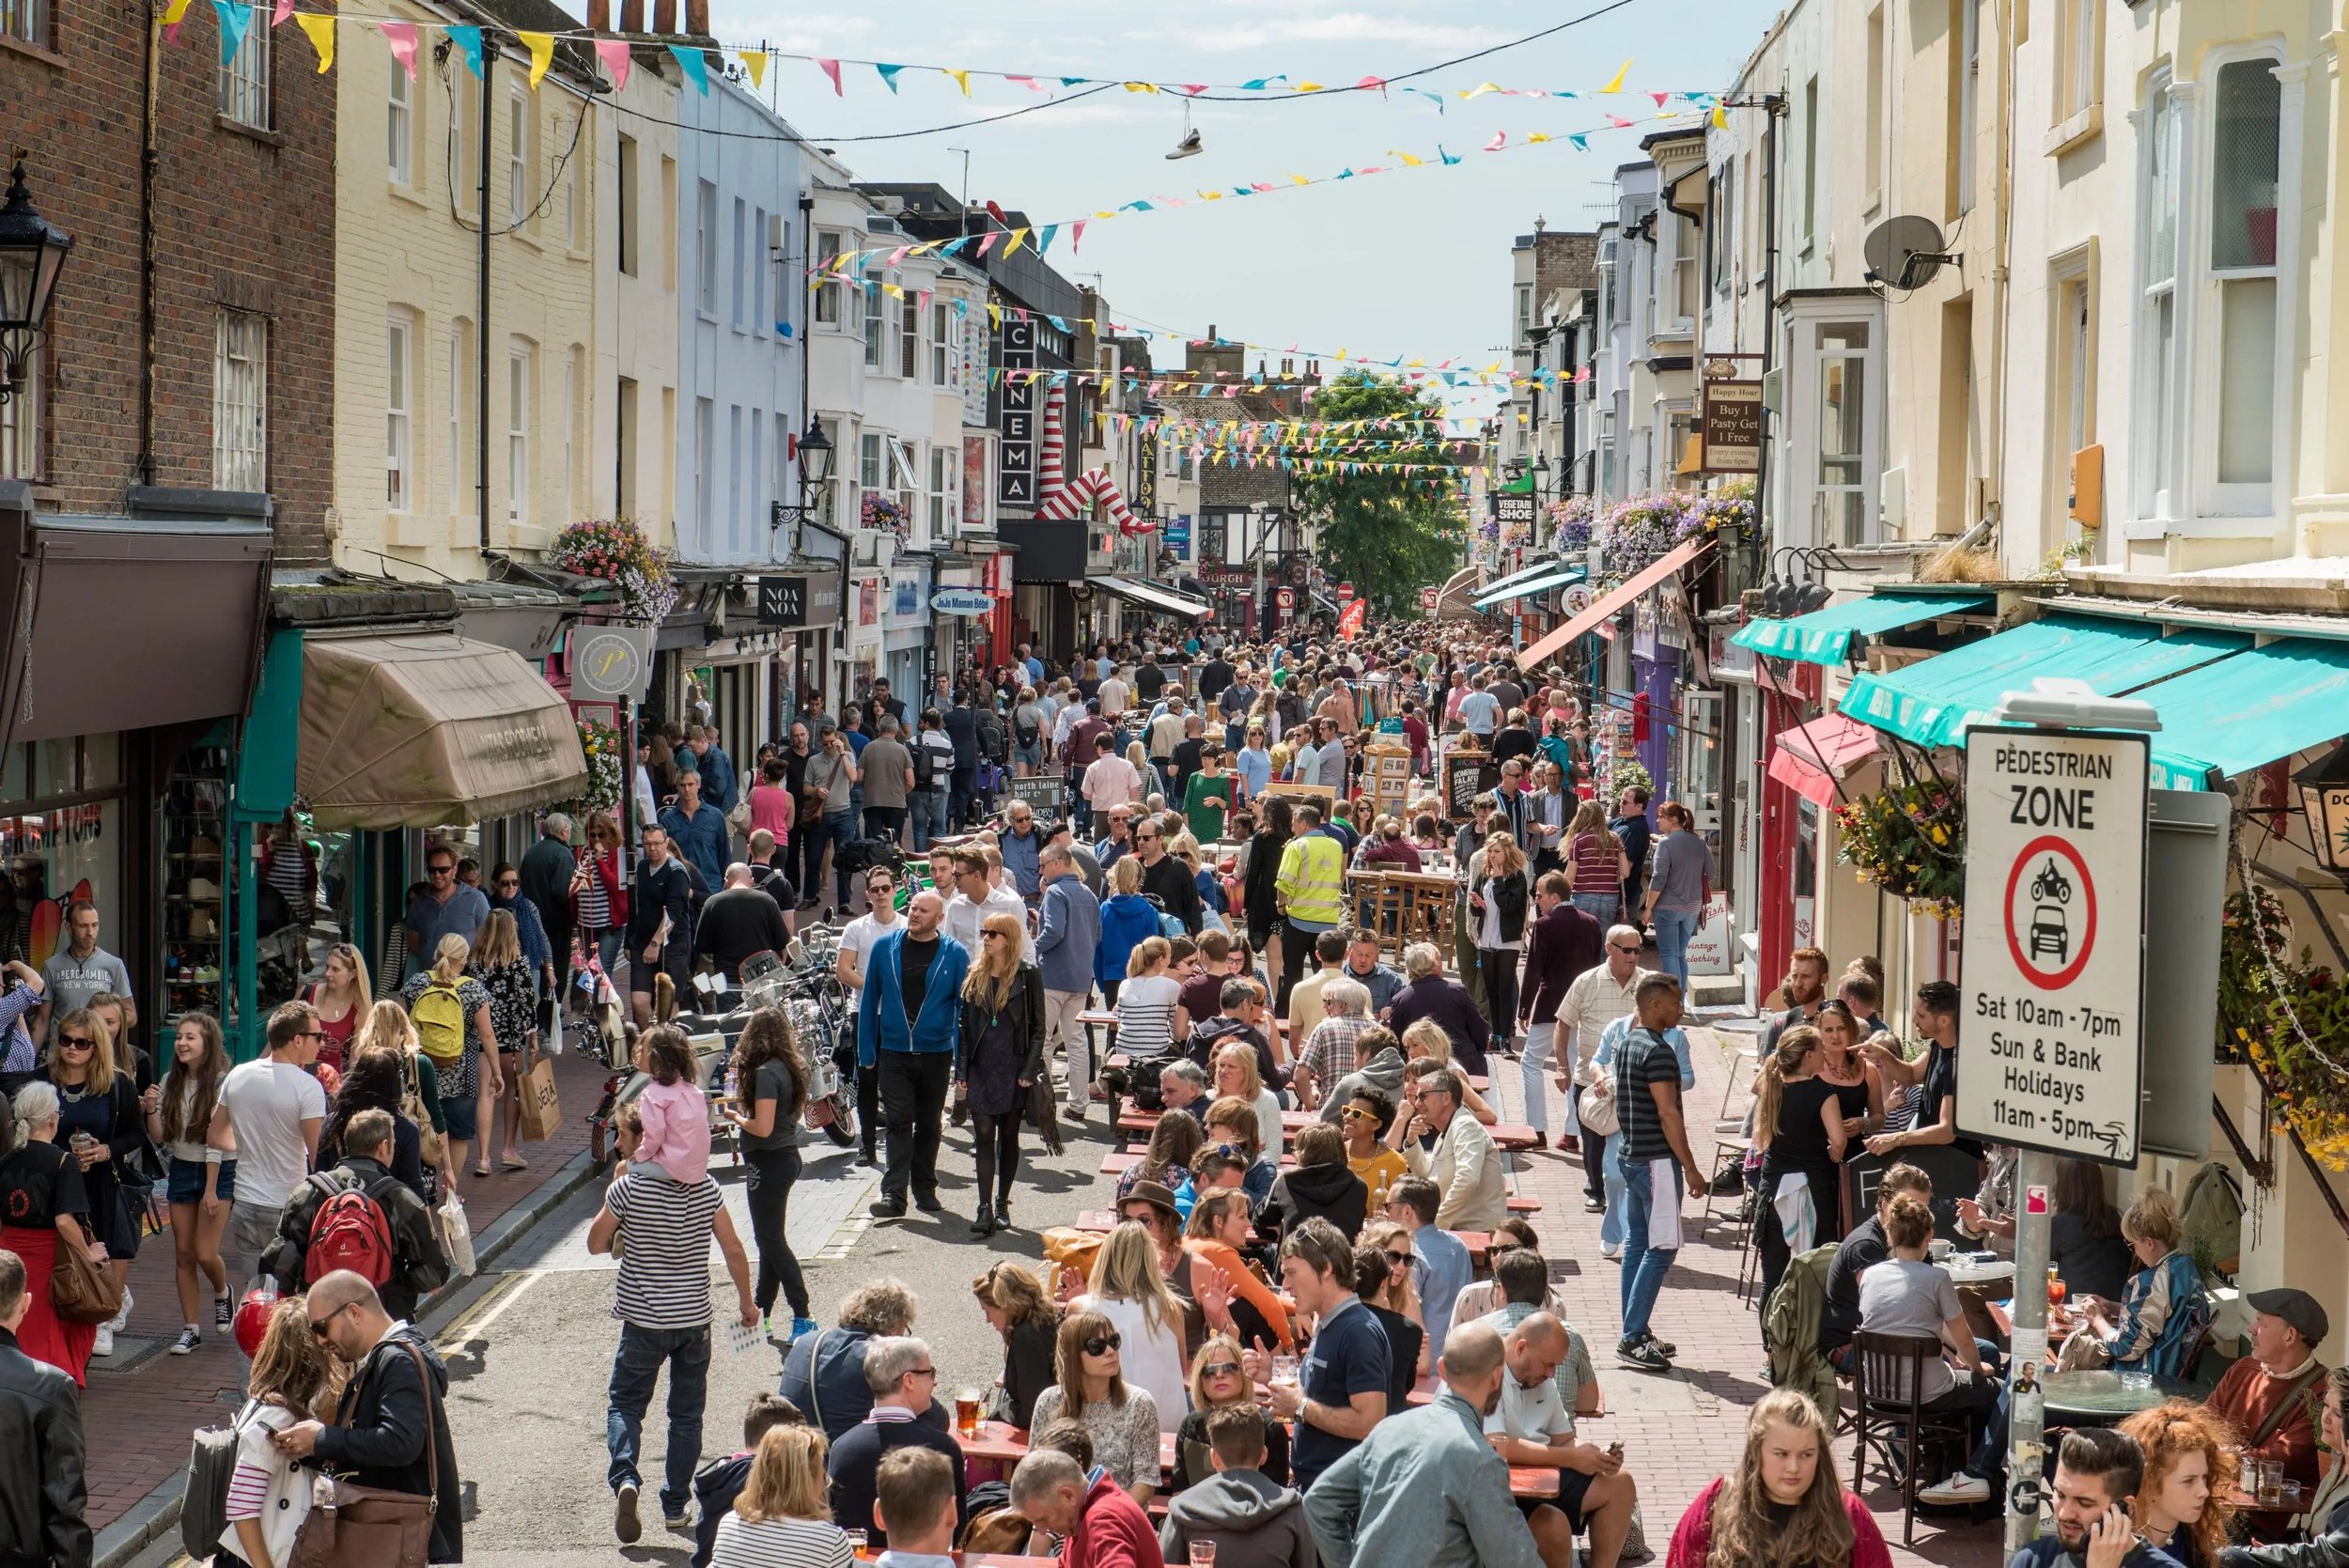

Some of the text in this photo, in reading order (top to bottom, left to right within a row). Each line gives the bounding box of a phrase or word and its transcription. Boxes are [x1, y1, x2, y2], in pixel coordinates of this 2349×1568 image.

[1713, 388, 1736, 396] Happy
[1008, 328, 1026, 495] CINEMA
[1719, 405, 1740, 416] Buy
[1710, 419, 1758, 430] Pasty Get
[1719, 433, 1750, 442] 1 Free
[1710, 448, 1757, 458] Every evening
[1734, 458, 1749, 466] 6pm
[1498, 500, 1532, 508] VEGETARI
[1498, 509, 1532, 520] SHOE
[766, 588, 799, 601] NOA
[766, 601, 799, 615] NOA
[937, 597, 988, 609] JoJo Maman Bébé
[1996, 749, 2111, 779] PEDESTRIAN
[1015, 781, 1060, 790] north laine
[1015, 790, 1031, 799] hair
[2011, 784, 2094, 830] ZONE
[1688, 942, 1718, 953] vintage
[1686, 955, 1720, 965] clothing
[57, 970, 109, 982] ABERCROMBIE
[84, 981, 105, 989] YORK
[1976, 992, 2006, 1019] Sat
[2015, 998, 2063, 1028] 10am
[2080, 1007, 2121, 1037] 7pm
[1990, 1032, 2101, 1072] Sun & Bank
[2004, 1065, 2084, 1105] Holidays
[1994, 1098, 2034, 1128] 11am
[2052, 1109, 2093, 1141] 5pm
